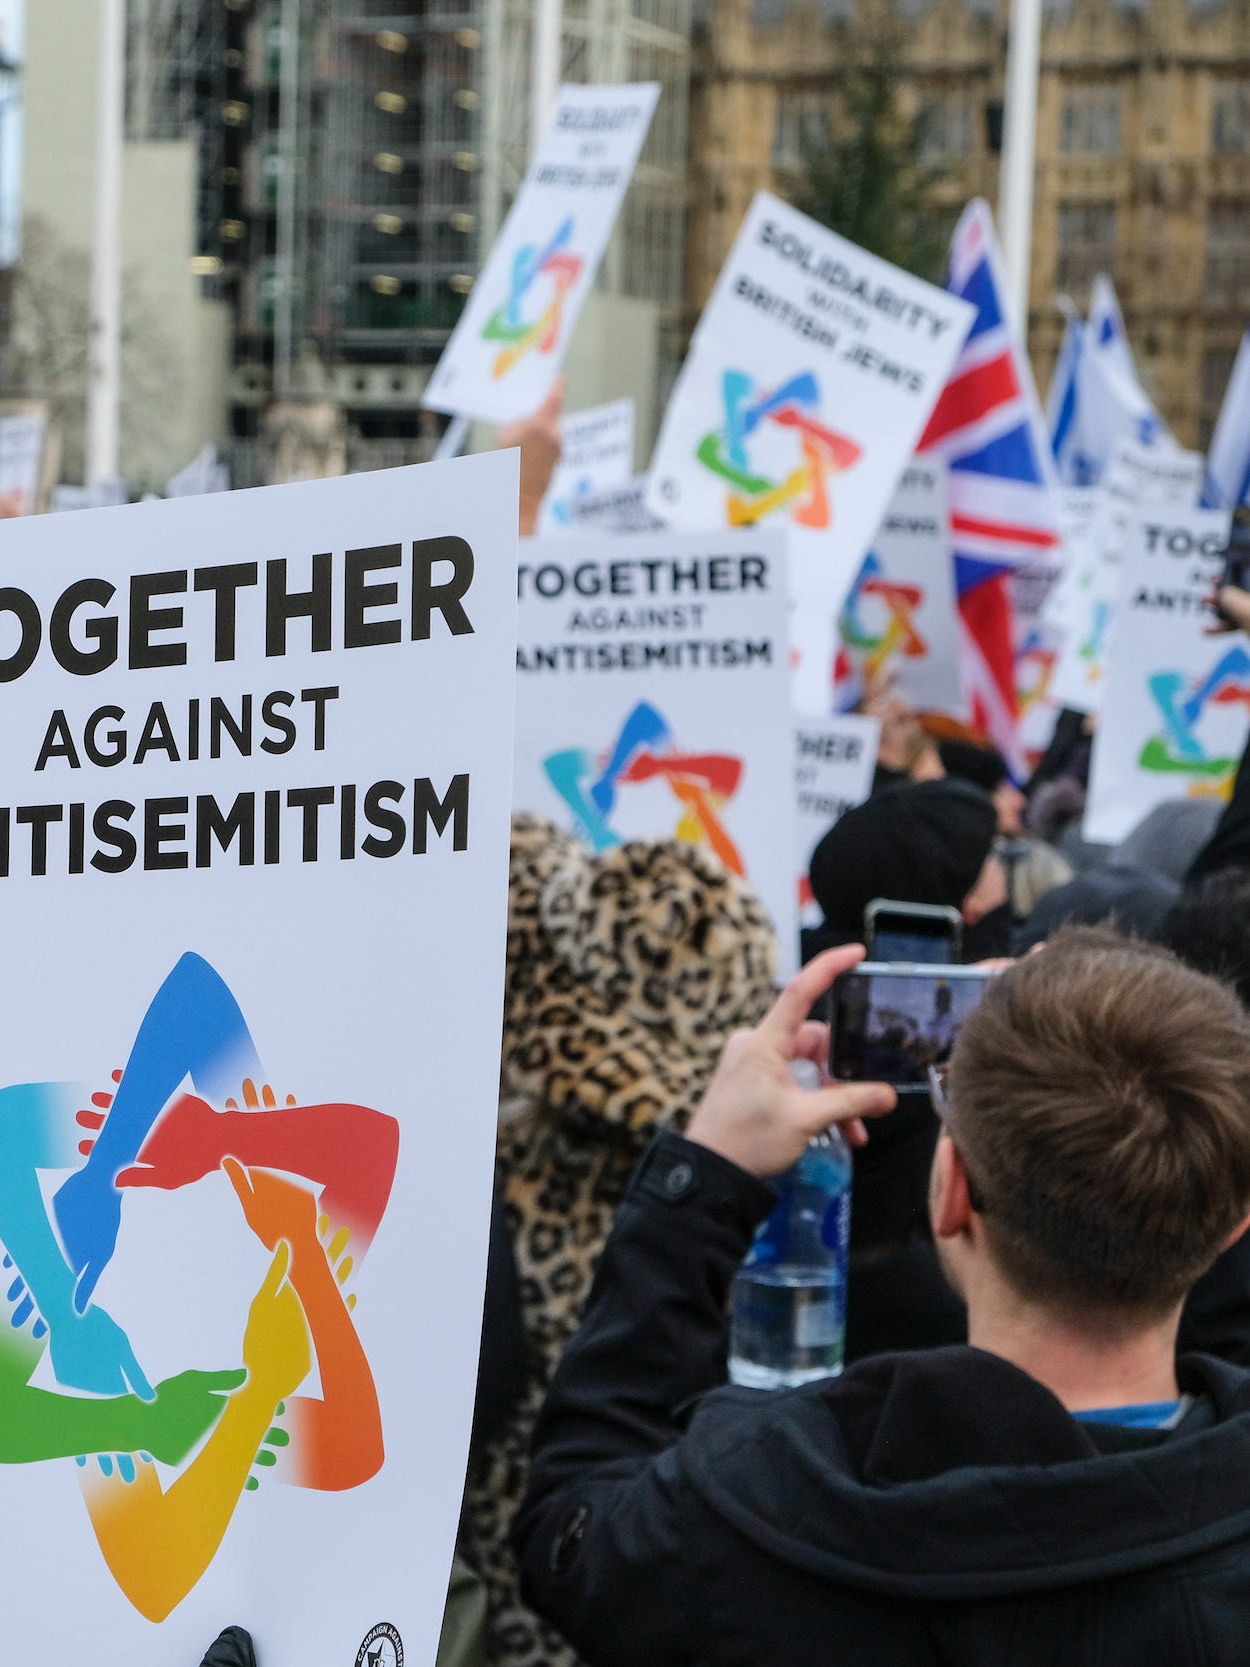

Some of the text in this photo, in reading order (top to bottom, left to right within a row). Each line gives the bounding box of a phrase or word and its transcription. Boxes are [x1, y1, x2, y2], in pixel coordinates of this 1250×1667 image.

[758, 219, 948, 340] SOLIDARITY
[735, 275, 924, 394] BRITISH JEWS
[569, 602, 707, 632] AGAINST
[515, 637, 772, 671] ANTISEMITISM
[33, 685, 340, 772] AGAINST
[357, 1624, 389, 1662] CAMPAIGN
